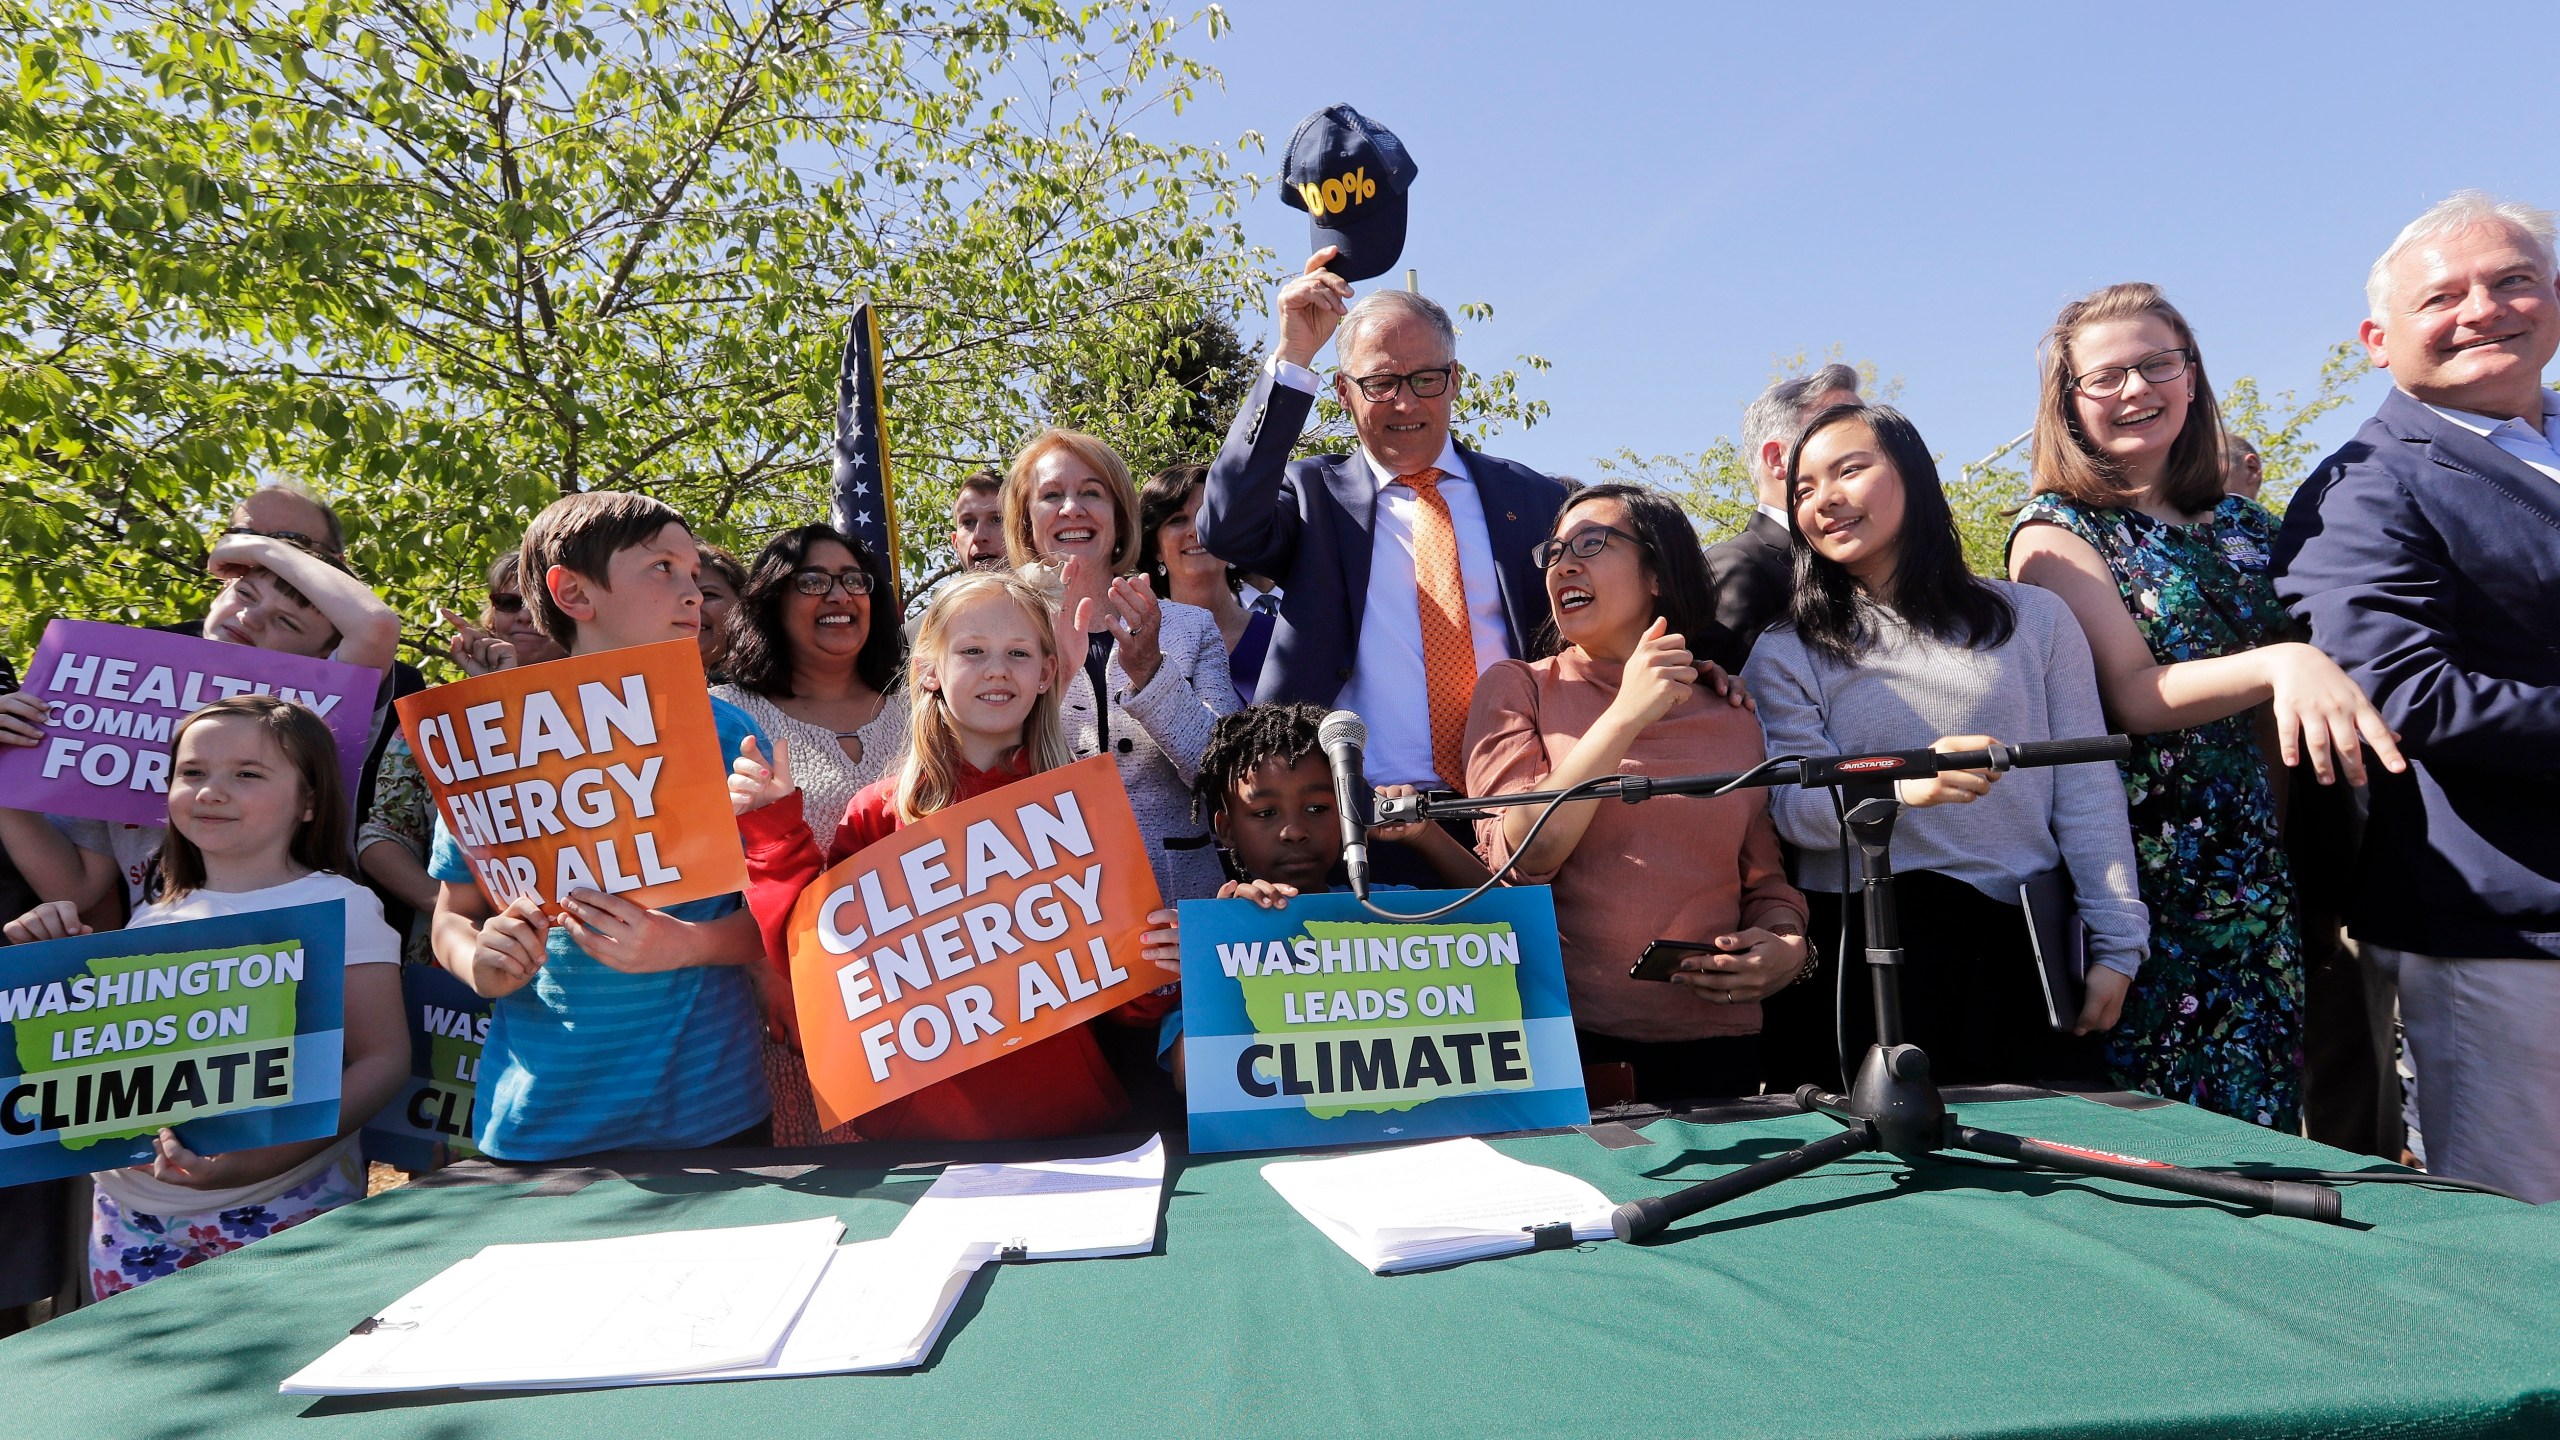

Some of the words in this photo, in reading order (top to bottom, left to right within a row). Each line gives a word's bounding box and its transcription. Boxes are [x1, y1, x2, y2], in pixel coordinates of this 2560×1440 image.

[41, 737, 171, 793] FOR
[418, 674, 658, 785] CLEAN
[446, 756, 664, 847] ENERGY
[475, 855, 545, 907] FOR
[556, 831, 681, 904] ALL
[817, 790, 1094, 955] CLEAN
[836, 863, 1102, 1022] ENERGY
[1215, 931, 1520, 978] WASHINGTON
[0, 948, 304, 1022] WASHINGTON
[860, 984, 1005, 1083] FOR
[1017, 936, 1128, 1023] ALL
[1284, 988, 1409, 1024] LEADS
[1417, 984, 1475, 1017] ON
[52, 1014, 178, 1062] LEADS
[187, 1005, 248, 1042] ON
[423, 1005, 492, 1045] WAS
[0, 1046, 289, 1136] CLIMATE
[1236, 1030, 1528, 1098] CLIMATE
[407, 1087, 475, 1138] CLI
